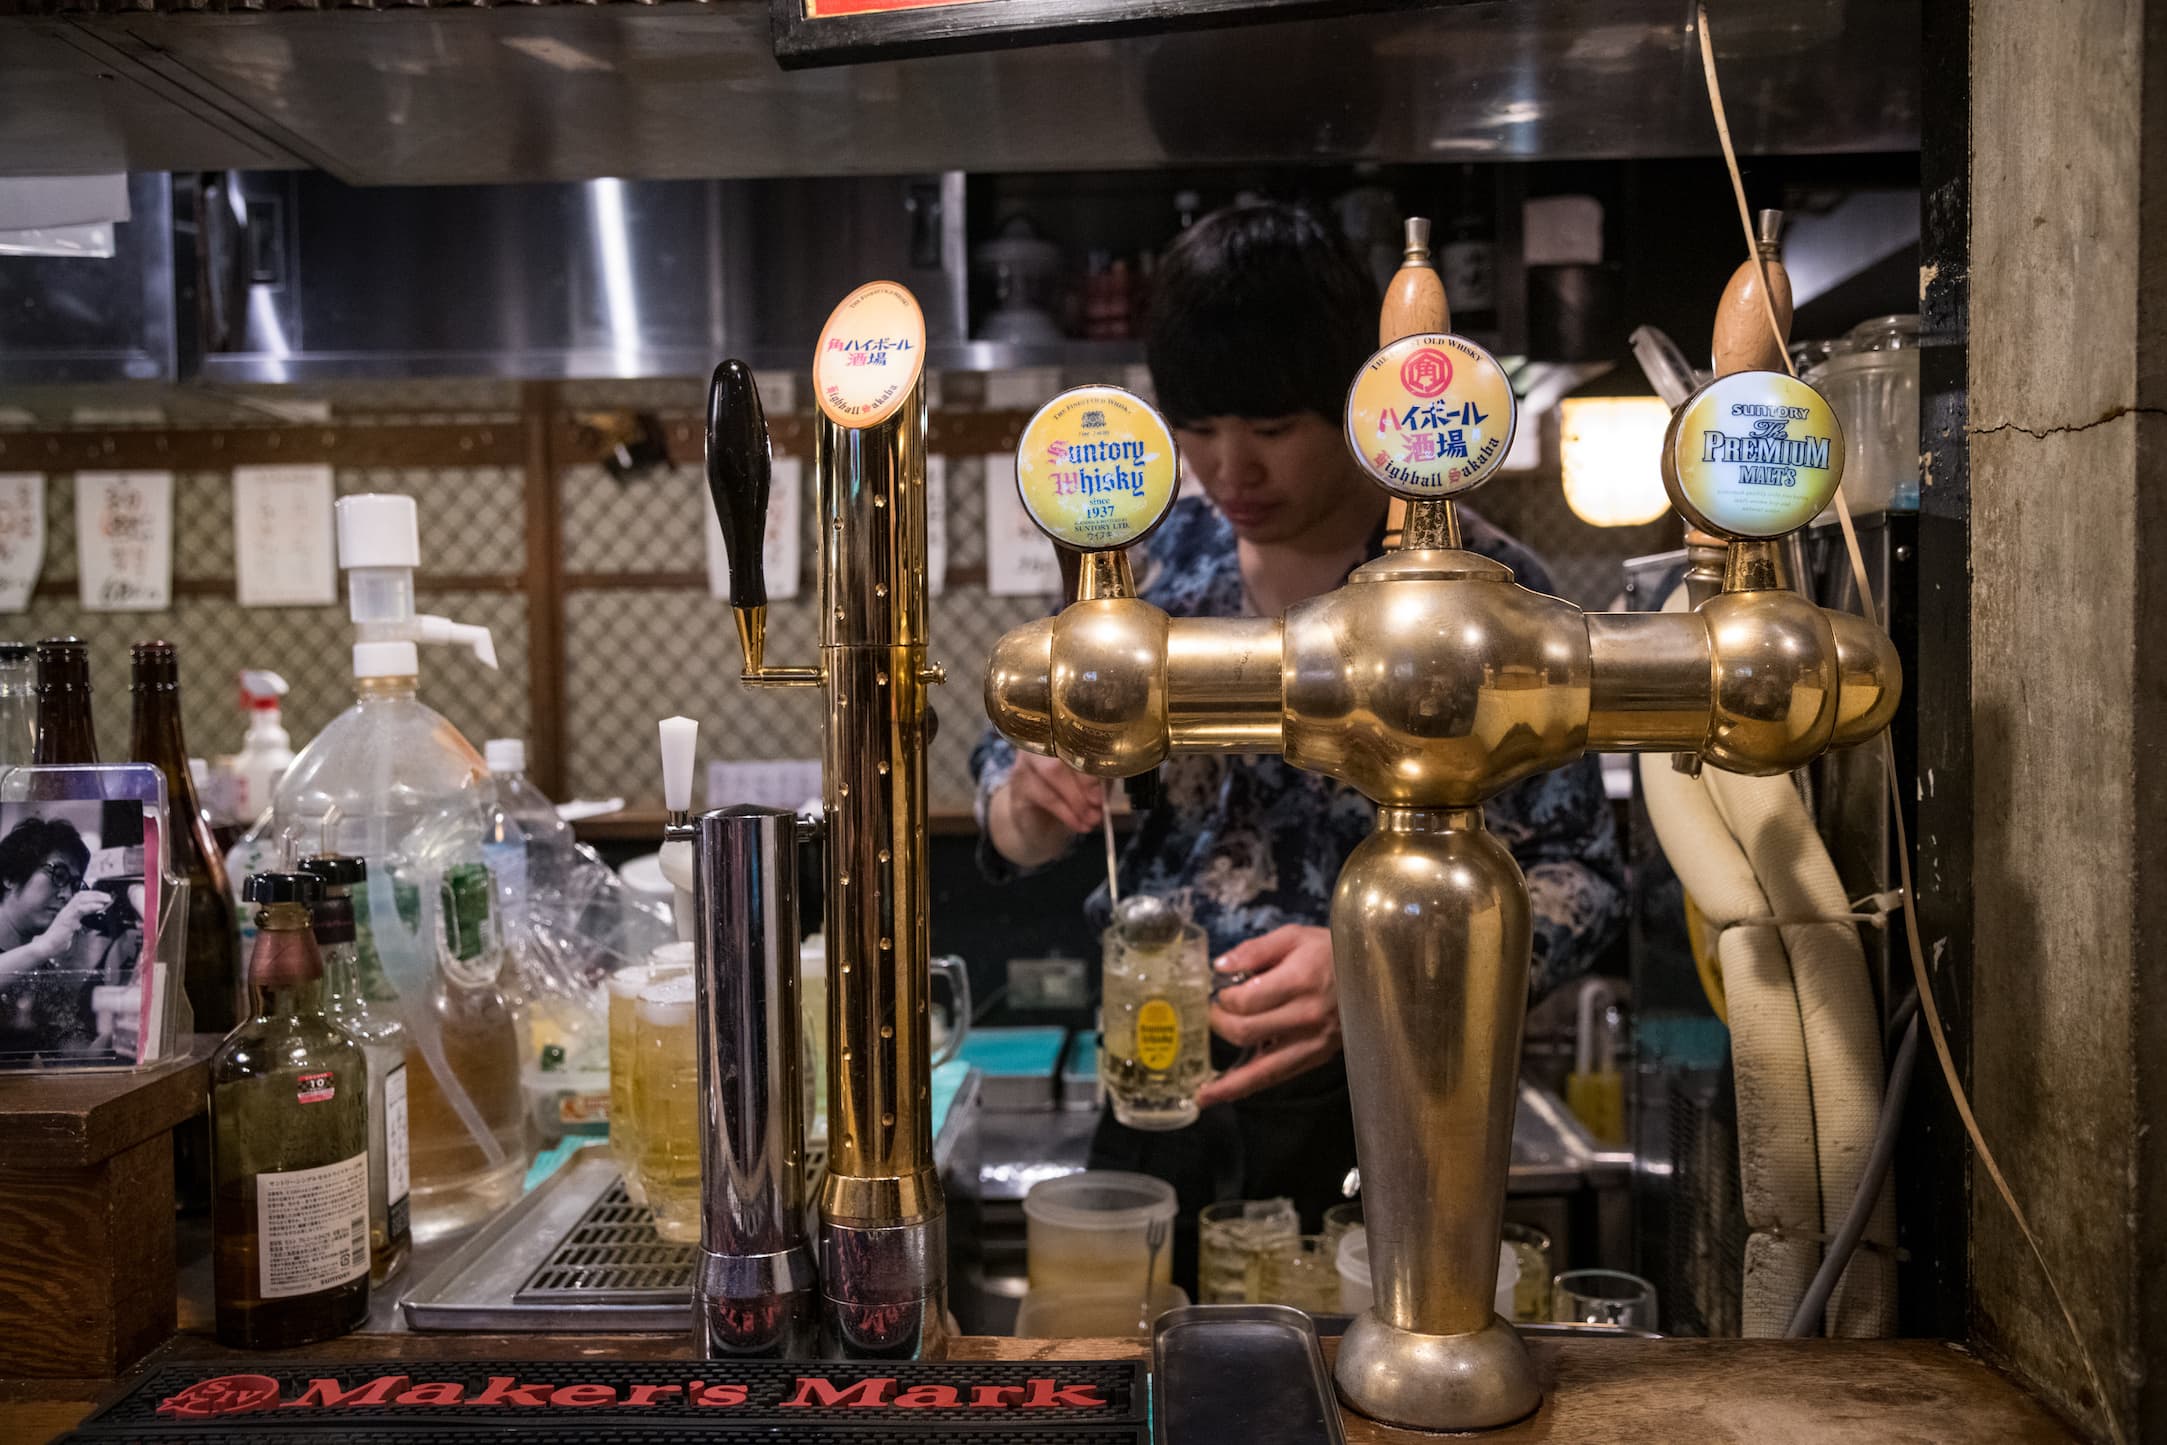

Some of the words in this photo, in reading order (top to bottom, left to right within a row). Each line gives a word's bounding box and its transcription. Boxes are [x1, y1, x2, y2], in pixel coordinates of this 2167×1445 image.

[827, 338, 915, 352] 角ハイボール
[1371, 356, 1390, 371] THE
[1423, 337, 1445, 345] OLD
[1448, 339, 1484, 362] WHISKY
[846, 352, 887, 366] 酒場
[1378, 398, 1489, 433] ハイボール
[1731, 403, 1810, 420] SUNTORY
[1749, 418, 1789, 439] The
[1047, 440, 1146, 467] Suntory
[1400, 429, 1468, 464] 酒場
[1702, 430, 1831, 470] PREMIUM
[1373, 450, 1443, 487] Highball
[1448, 437, 1500, 483] Sakaba
[1048, 464, 1146, 497] Whisky
[1738, 465, 1797, 487] MALT'S
[1086, 505, 1115, 519] 1937
[1089, 497, 1111, 505] since
[1074, 524, 1110, 532] SUNTORY
[1113, 522, 1130, 530] LTD.
[310, 1078, 325, 1088] 10
[279, 1375, 748, 1407] Maker's
[779, 1377, 1107, 1408] Mark
